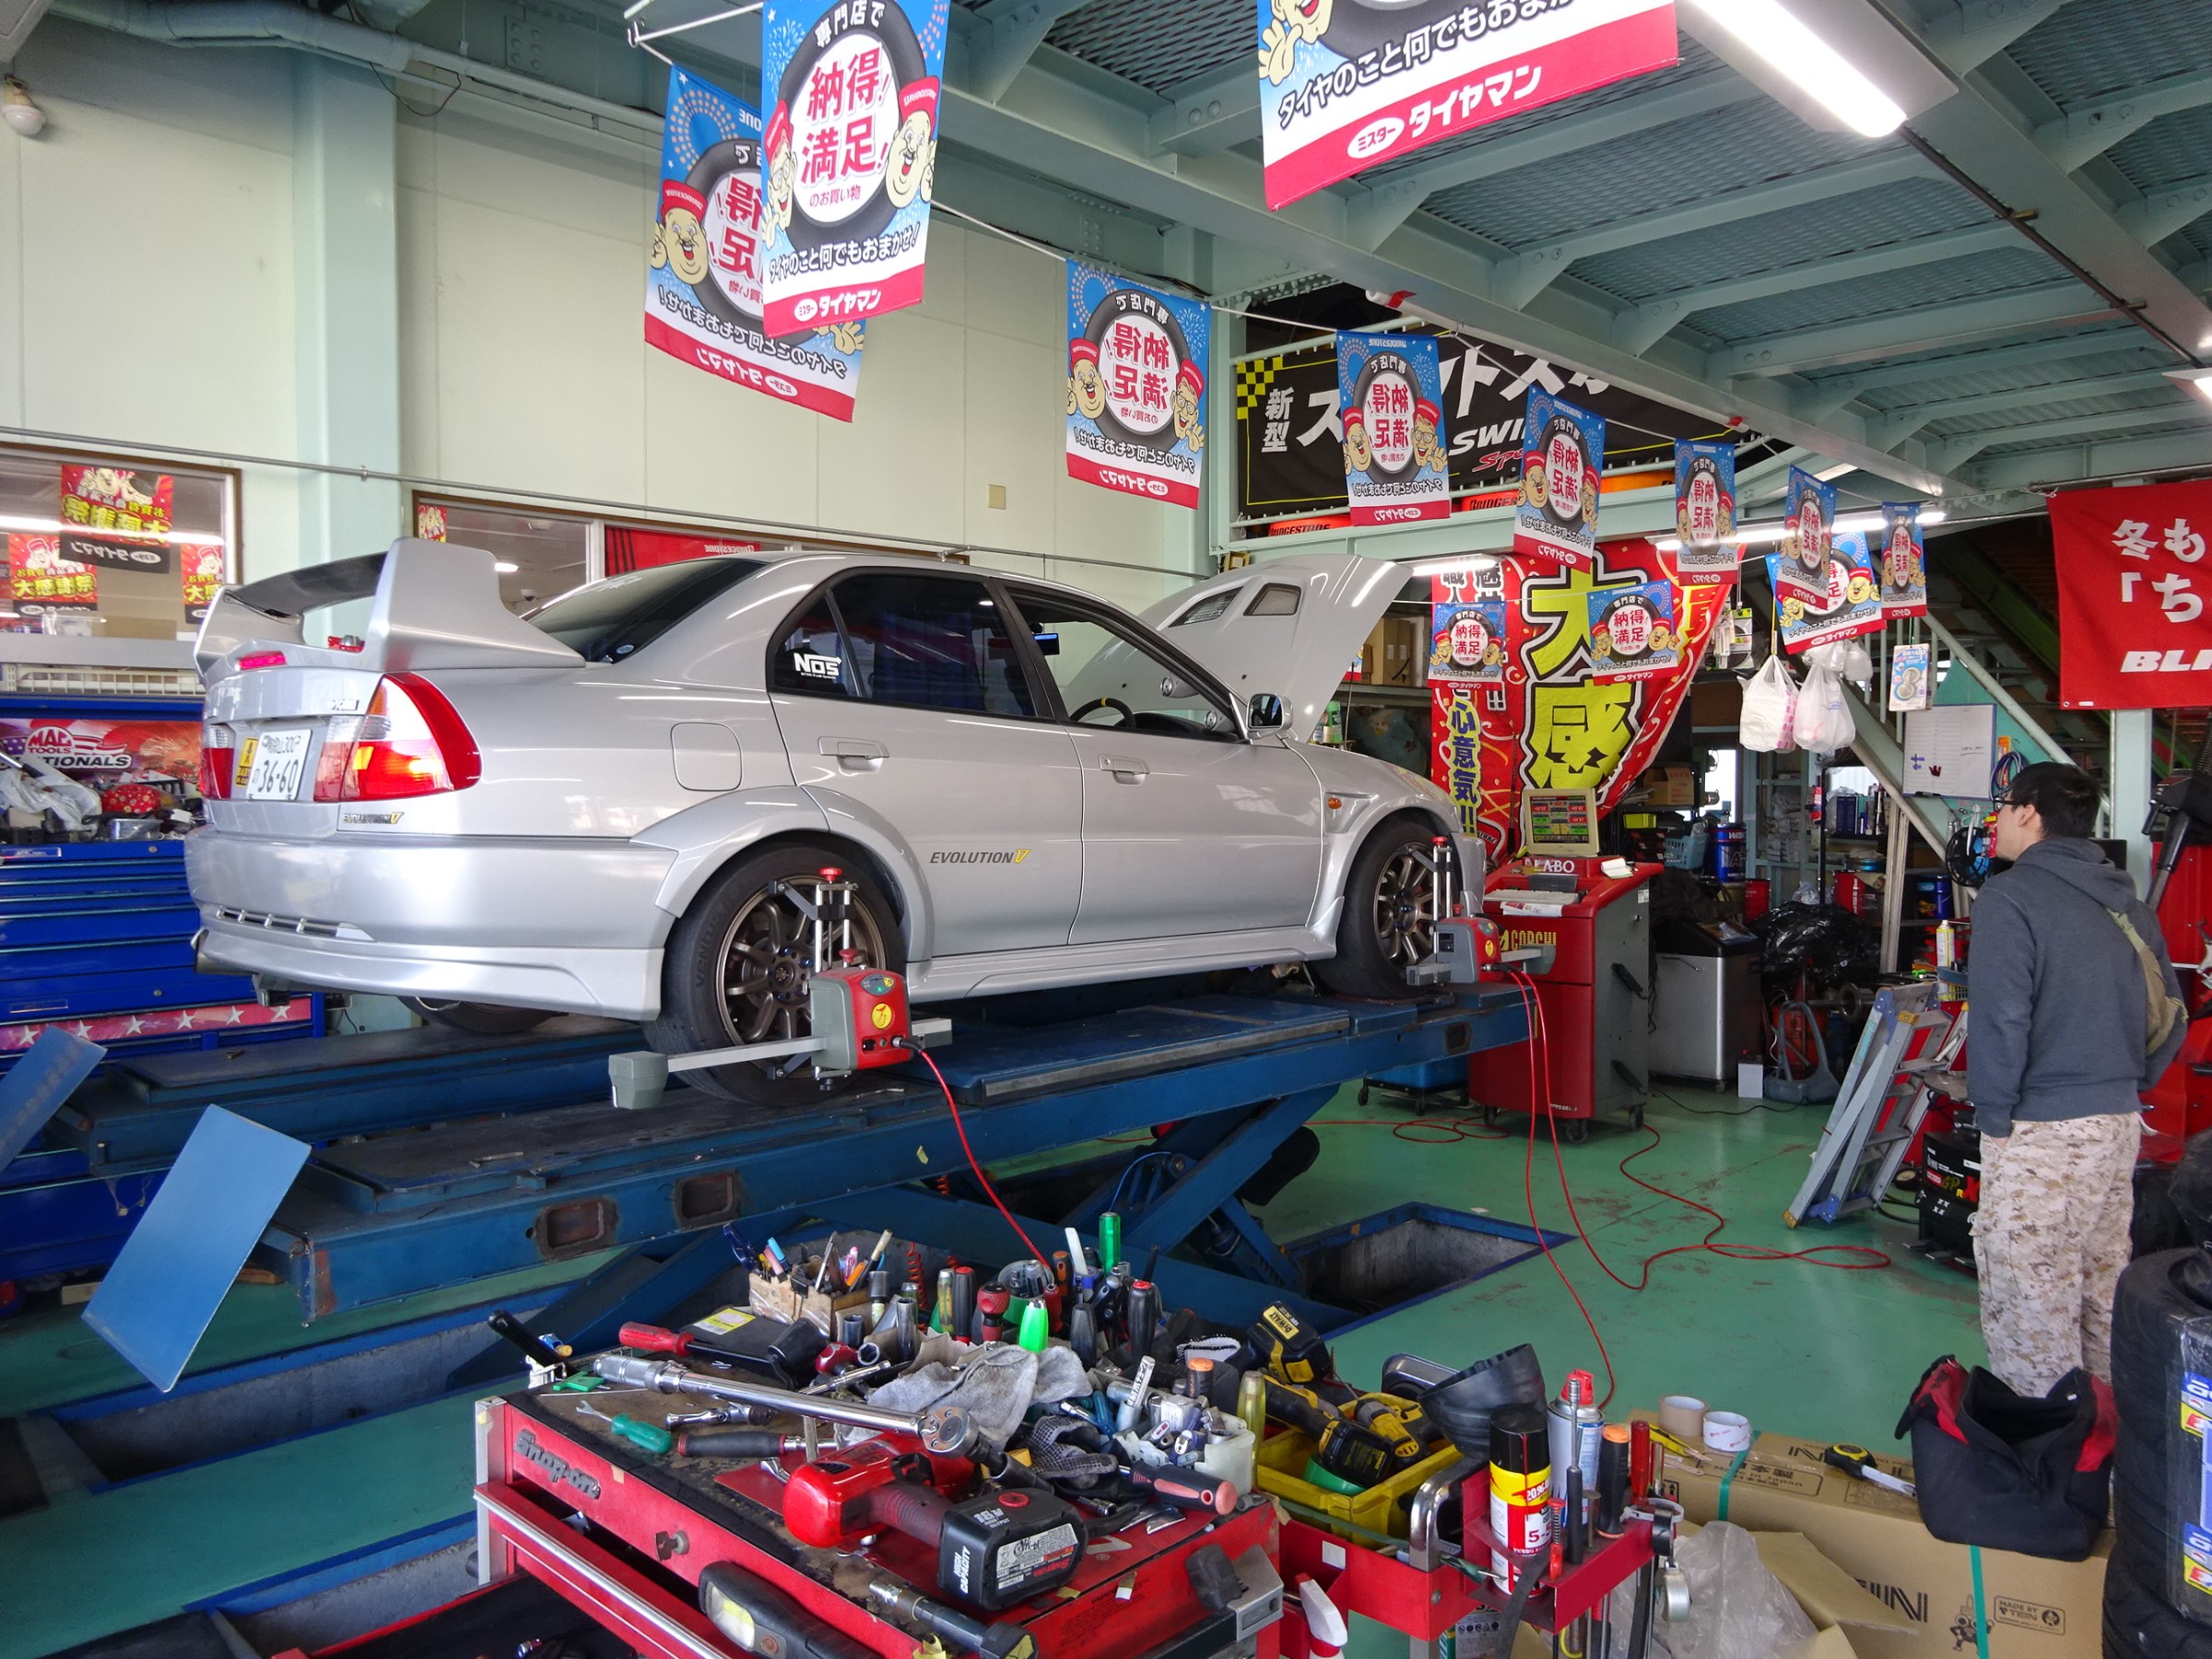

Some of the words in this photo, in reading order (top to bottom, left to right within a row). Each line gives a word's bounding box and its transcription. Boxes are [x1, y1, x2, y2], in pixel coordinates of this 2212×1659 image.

[814, 0, 885, 47] 専門店で
[1277, 0, 1568, 130] タイヤのこと何でもおま
[1357, 124, 1396, 152] ミスター
[1408, 65, 1542, 139] タイヤマン
[809, 184, 861, 207] のお買い物
[818, 289, 881, 317] タイヤマン
[1262, 387, 1294, 453] 新型
[1448, 418, 1526, 456] SWI
[2111, 518, 2206, 563] 冬も
[794, 653, 840, 677] NOS
[2121, 649, 2212, 673] BLI
[44, 756, 129, 767] TIONALS
[930, 852, 1014, 864] EVOLUTION
[959, 1546, 971, 1594] CAPACITY
